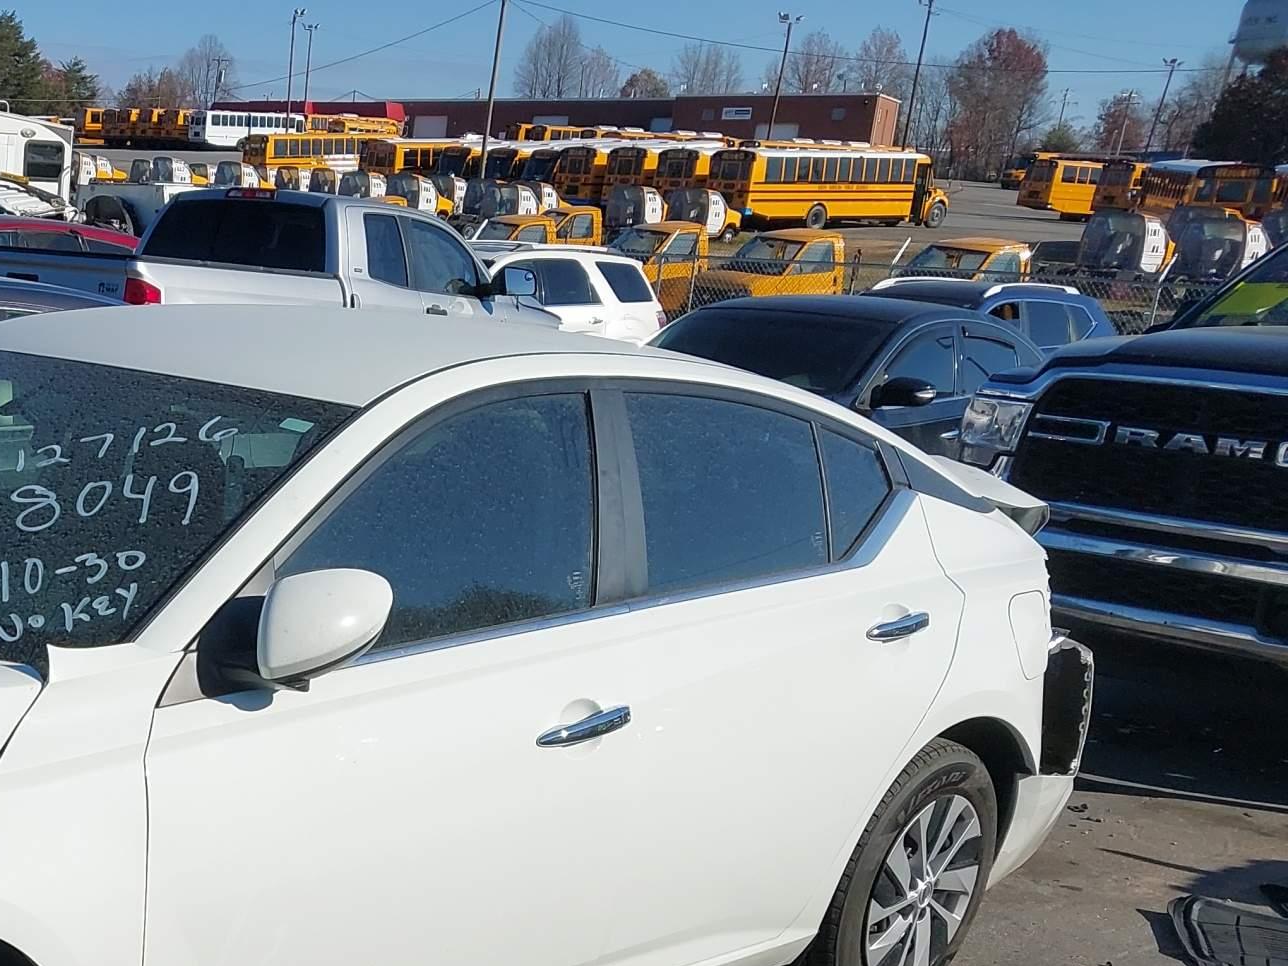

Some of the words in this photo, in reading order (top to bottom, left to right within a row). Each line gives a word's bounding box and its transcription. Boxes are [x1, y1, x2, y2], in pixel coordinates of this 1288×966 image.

[1114, 425, 1268, 459] RAM
[11, 471, 200, 532] 8049
[1, 551, 146, 602] 10-30
